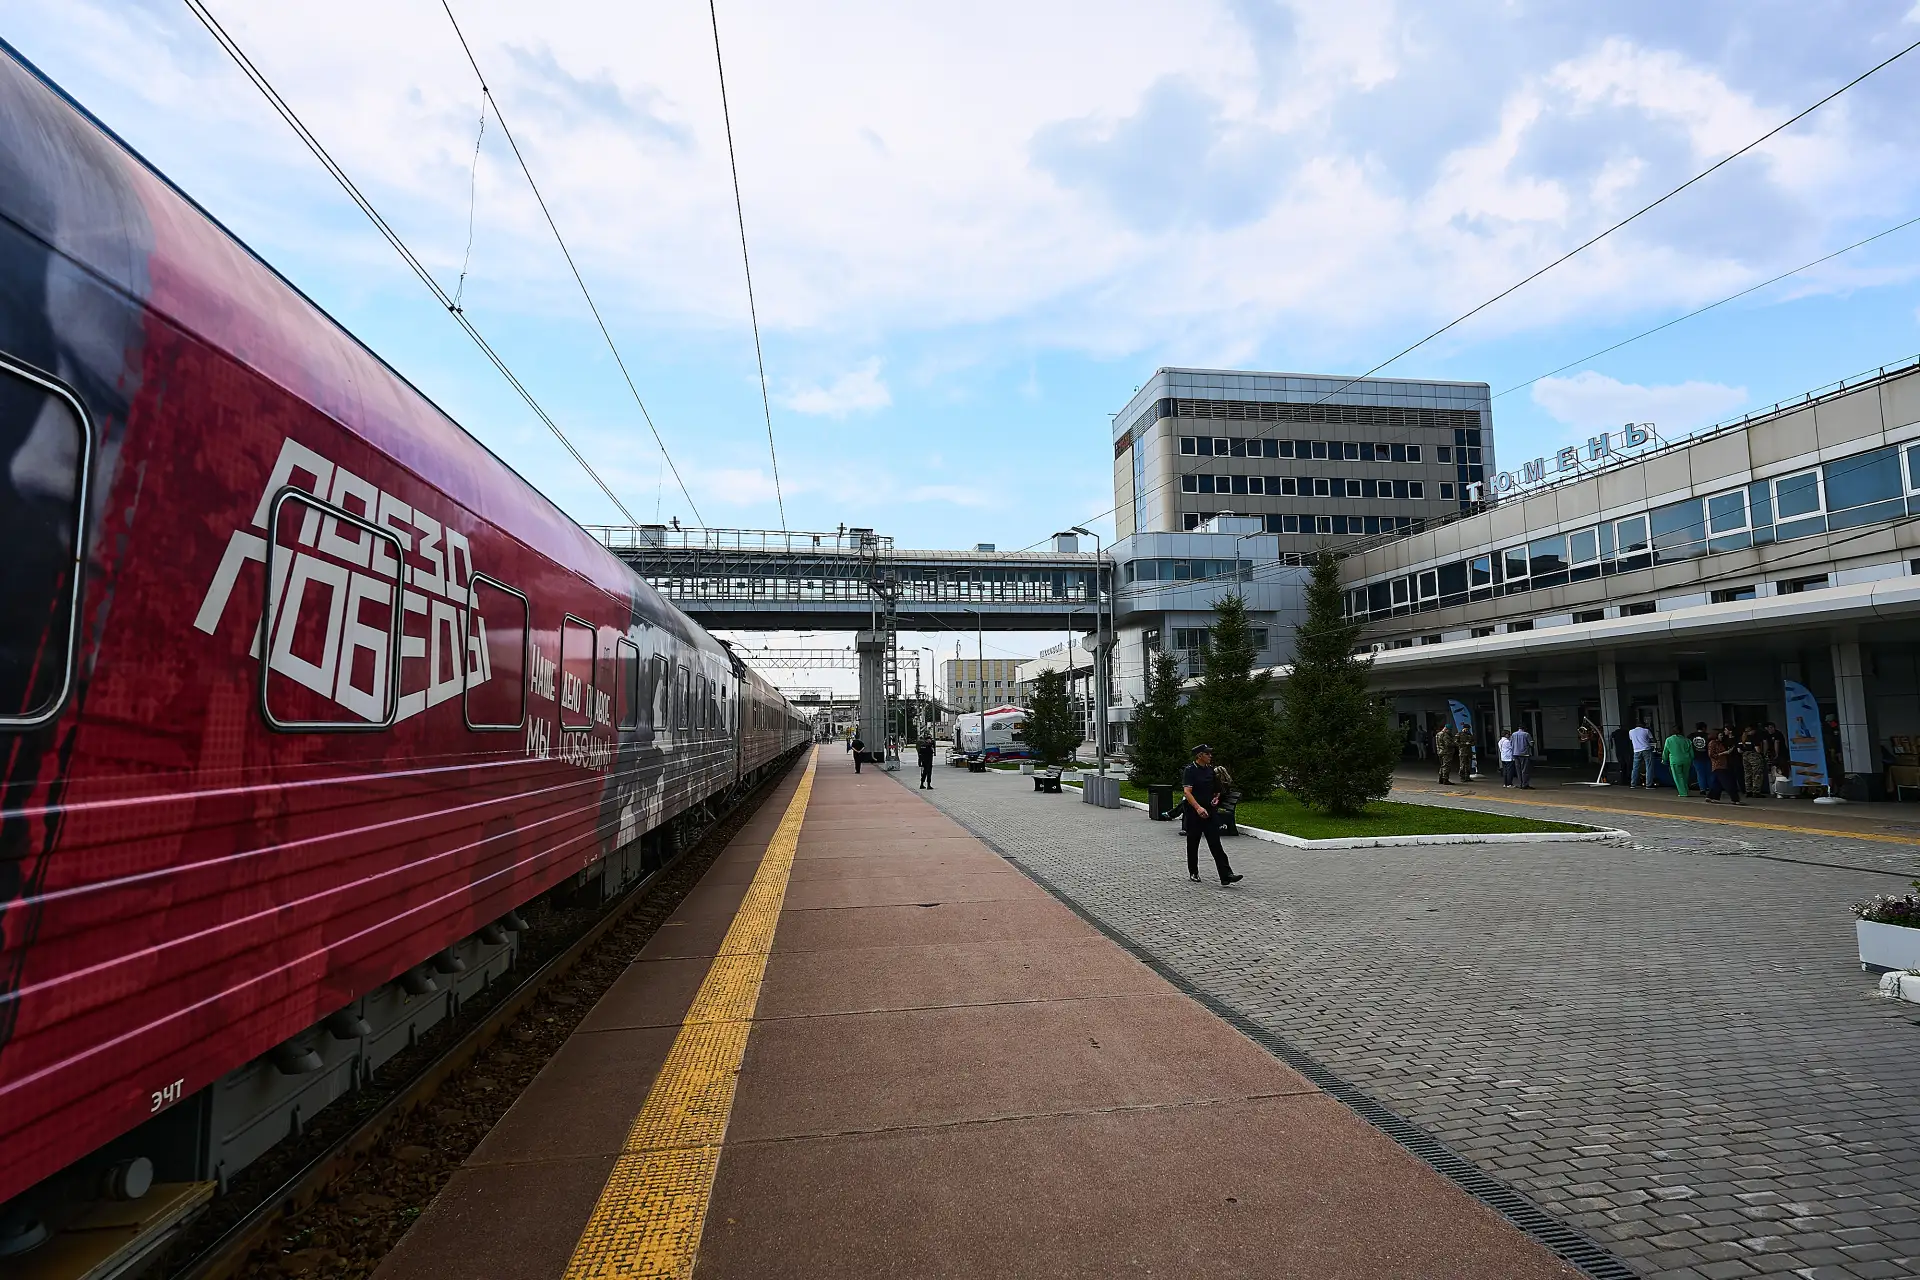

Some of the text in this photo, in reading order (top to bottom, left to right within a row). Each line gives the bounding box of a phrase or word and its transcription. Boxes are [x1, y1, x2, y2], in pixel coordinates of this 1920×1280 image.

[1466, 423, 1648, 502] ТЮМЕНЬ
[251, 436, 479, 610] ПОЕЗД
[193, 529, 491, 724] ПОБЕДЫ
[561, 670, 581, 714] ДЕЛО
[526, 714, 551, 759] МЫ
[150, 1077, 185, 1113] ЭЧТ
